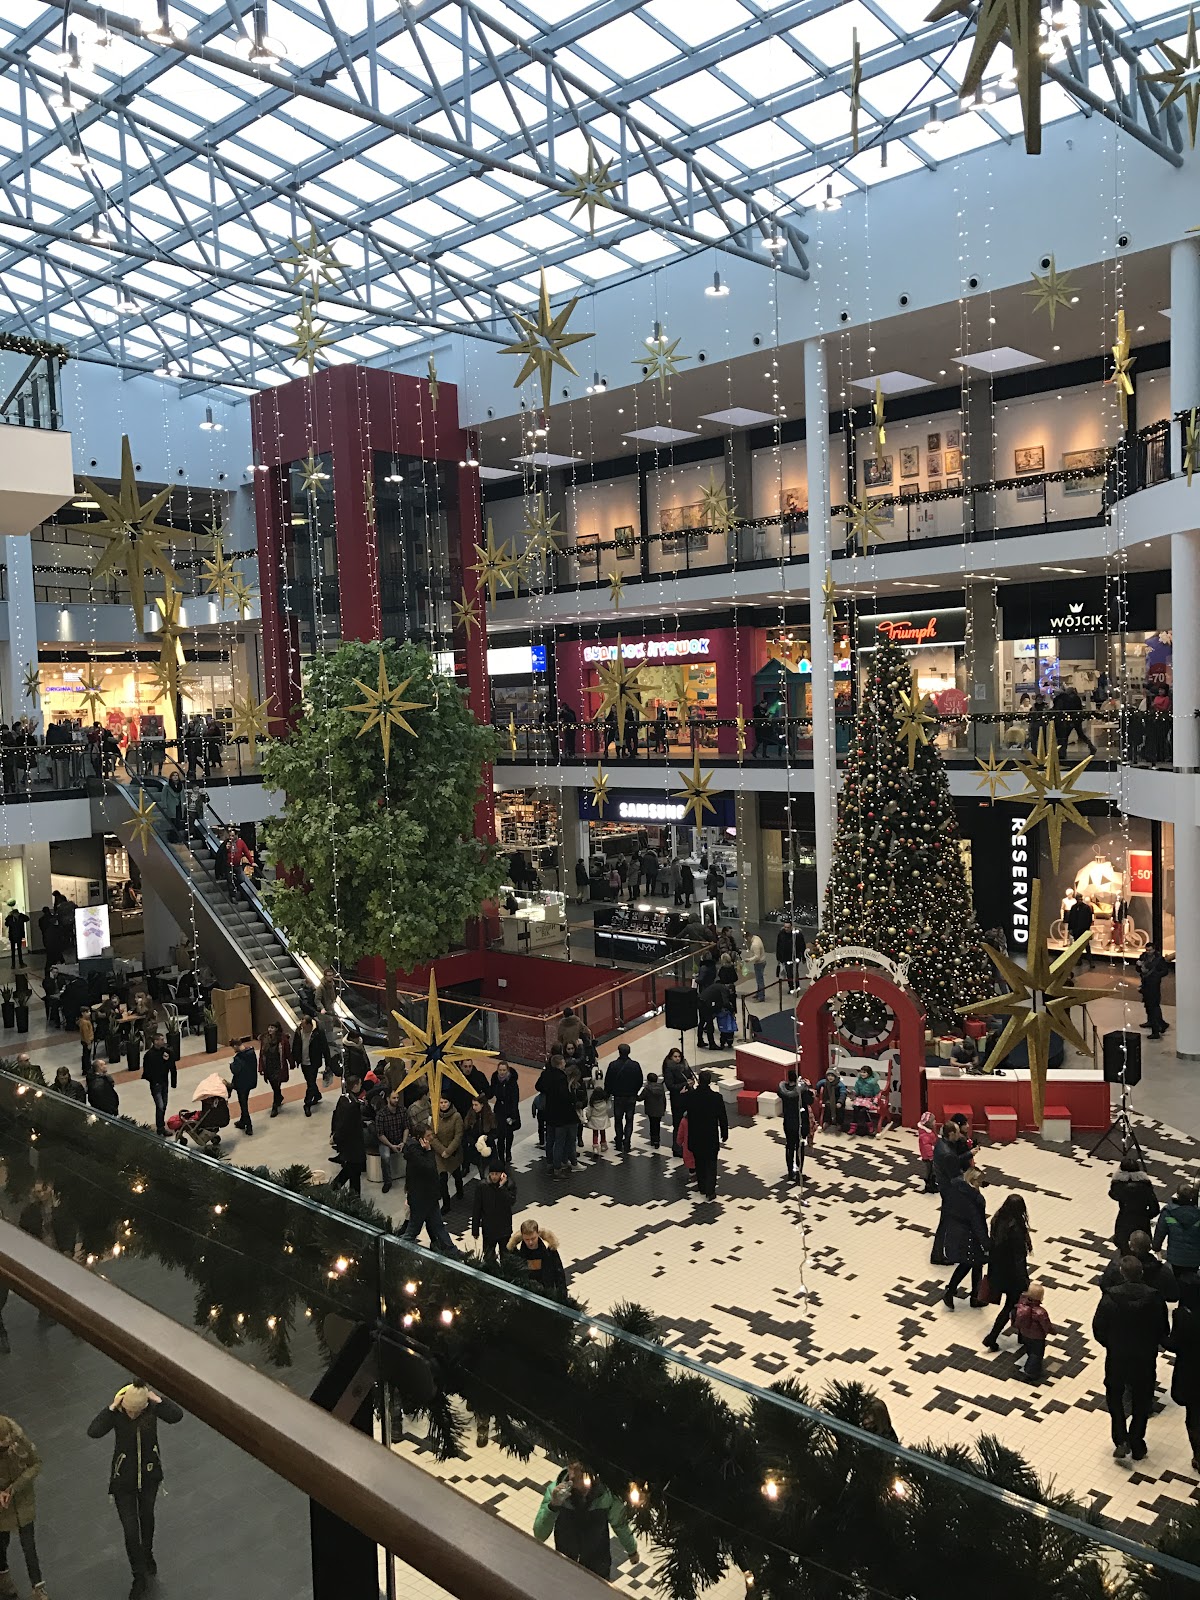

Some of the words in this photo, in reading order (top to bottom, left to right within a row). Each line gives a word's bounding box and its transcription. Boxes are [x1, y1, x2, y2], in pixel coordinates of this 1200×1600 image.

[878, 617, 937, 645] Triumph
[619, 802, 686, 820] SAMSUNG
[1011, 817, 1029, 944] RESERVED
[637, 942, 656, 953] NYX
